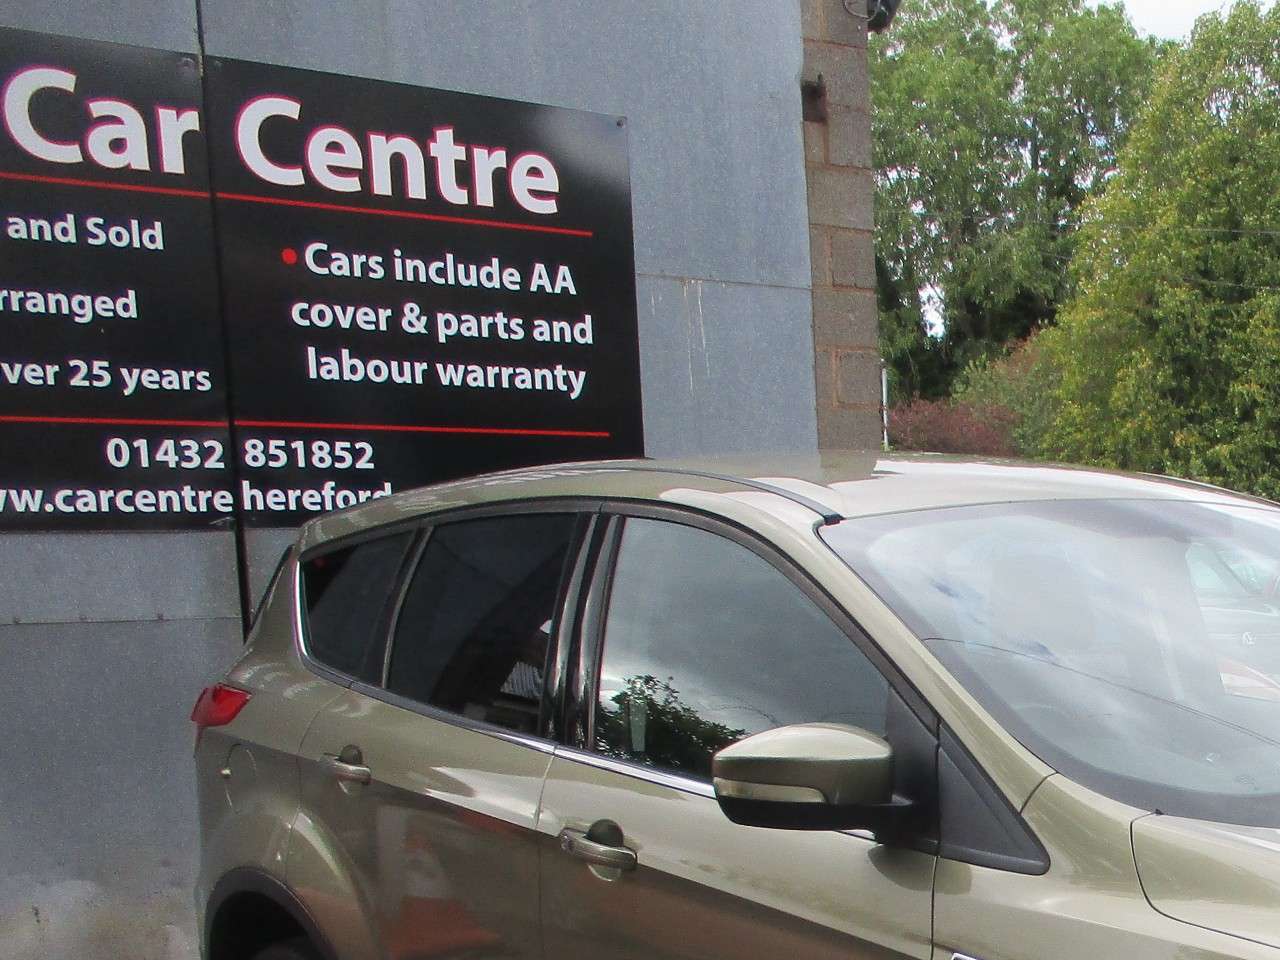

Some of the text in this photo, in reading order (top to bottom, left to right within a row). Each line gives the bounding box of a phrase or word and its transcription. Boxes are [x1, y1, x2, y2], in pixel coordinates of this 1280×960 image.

[2, 65, 561, 216] Car Centre
[7, 213, 164, 250] and Sold
[304, 242, 577, 295] Cars include AA
[291, 302, 593, 344] cover & parts and
[68, 359, 112, 388] 25
[119, 367, 212, 396] years
[307, 346, 587, 400] labour warranty
[106, 437, 375, 469] 01432 851852
